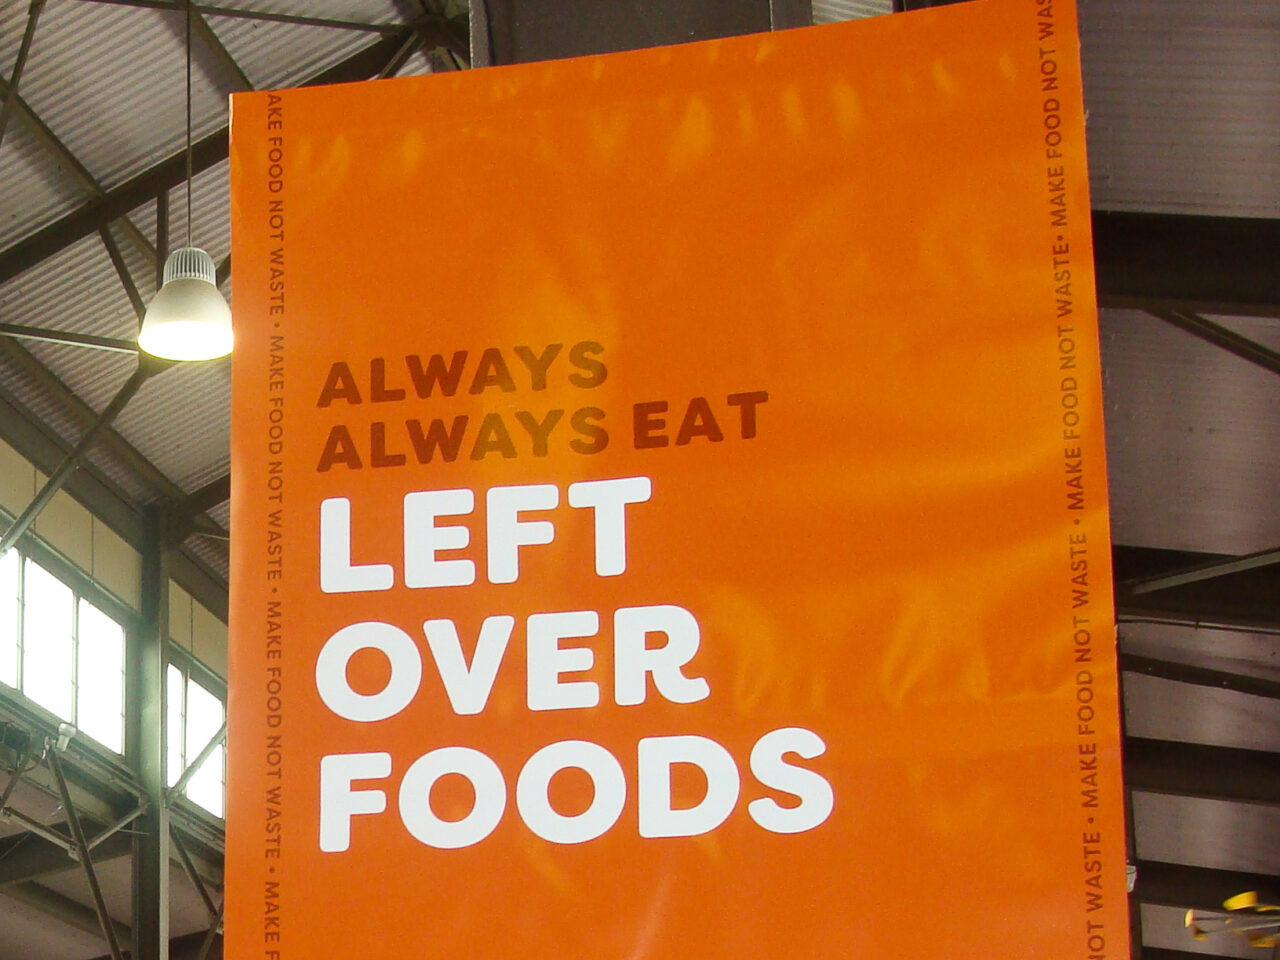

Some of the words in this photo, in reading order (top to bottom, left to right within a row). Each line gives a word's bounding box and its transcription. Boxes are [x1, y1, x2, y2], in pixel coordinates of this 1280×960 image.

[1040, 48, 1058, 92] NOT
[267, 90, 282, 130] AKE
[1044, 98, 1062, 160] FOOD
[268, 138, 283, 193] FOOD
[1047, 166, 1067, 227] MAKE
[269, 200, 284, 241] NOT
[269, 248, 284, 315] WASTE
[1053, 242, 1071, 319] WASTE
[269, 335, 284, 391] MAKE
[316, 341, 608, 408] ALWAYS
[1058, 326, 1076, 370] NOT
[269, 399, 284, 455] FOOD
[316, 407, 609, 472] ALWAYS
[632, 391, 768, 449] EAT
[1061, 377, 1081, 440] FOOD
[268, 462, 283, 503] NOT
[1066, 447, 1084, 510] MAKE
[267, 510, 282, 579] WASTE
[320, 476, 652, 593] LEFT
[1070, 533, 1089, 609] WASTE
[267, 602, 281, 659] MAKE
[1074, 616, 1091, 662] NOT
[315, 605, 710, 722] OVER
[266, 668, 282, 728] FOOD
[1076, 670, 1095, 736] FOOD
[266, 735, 282, 779] NOT
[1079, 743, 1098, 808] MAKE
[320, 727, 834, 852] FOODS
[265, 786, 281, 859] WASTE
[1083, 832, 1102, 912] WASTE
[265, 881, 280, 942] MAKE
